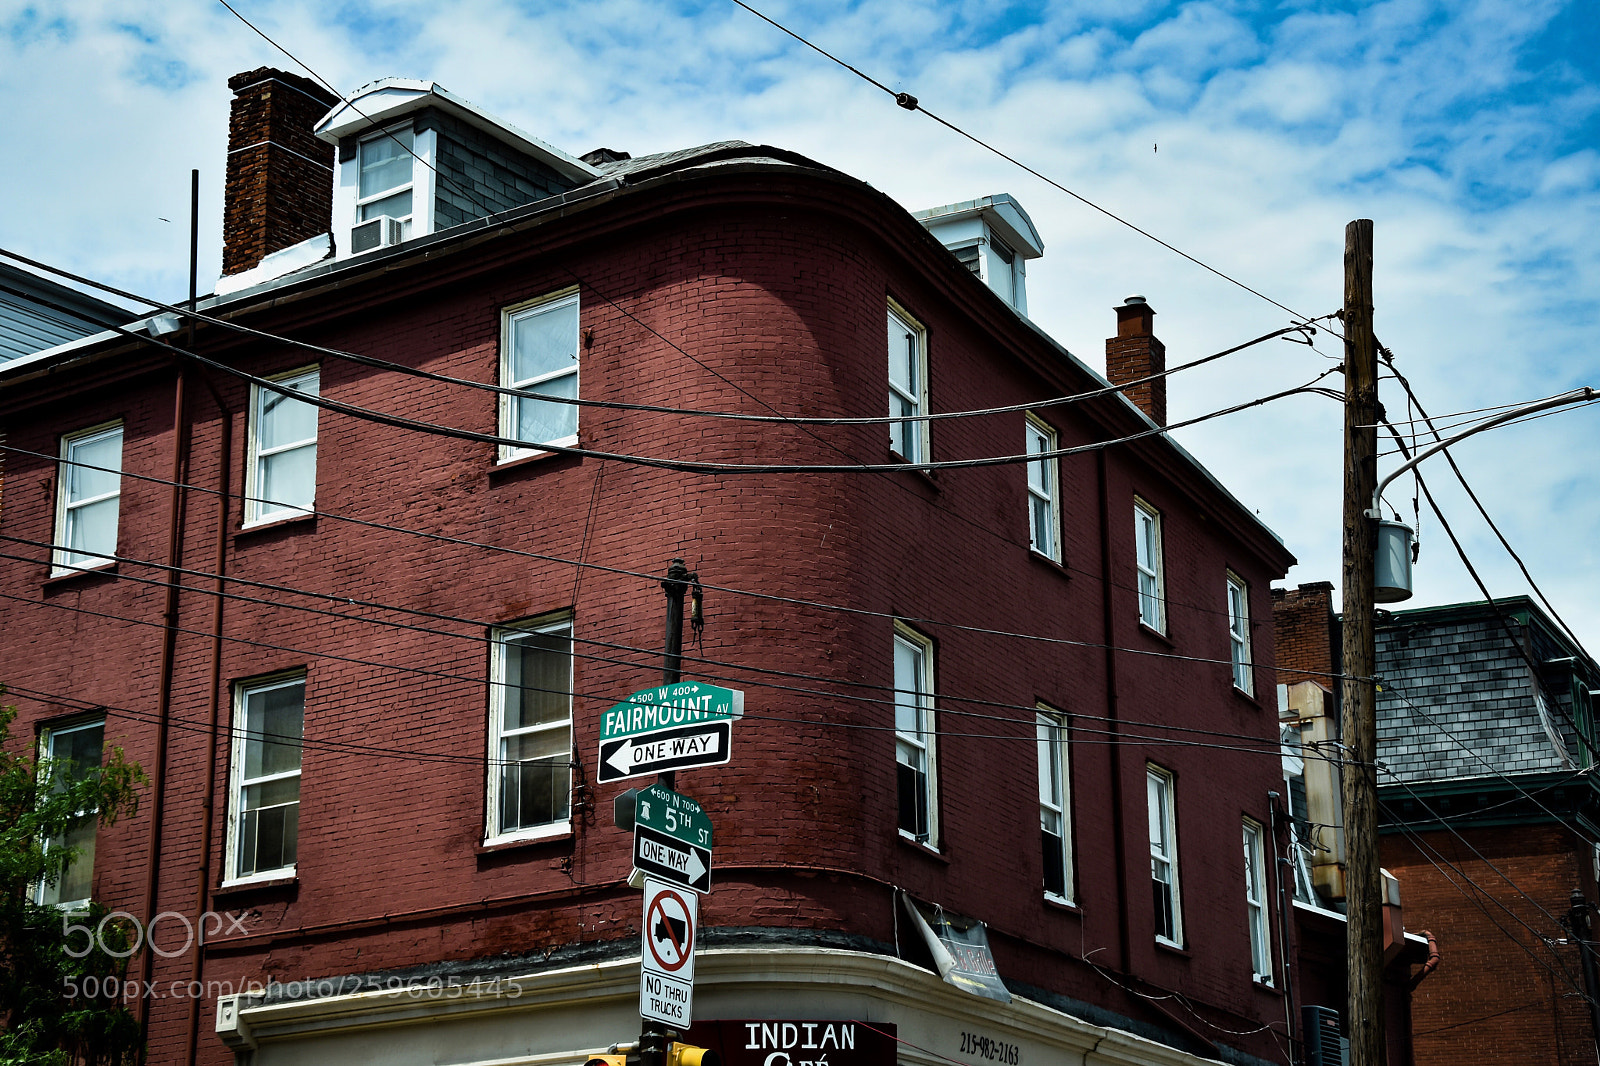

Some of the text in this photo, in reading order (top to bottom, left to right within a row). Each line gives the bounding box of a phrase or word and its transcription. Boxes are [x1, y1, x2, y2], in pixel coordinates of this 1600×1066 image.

[638, 685, 691, 703] 500 W 400
[604, 694, 729, 736] FAIRMOUNT AV
[633, 735, 712, 763] ONE WAY
[656, 789, 695, 812] 600 N 700
[665, 806, 709, 845] 5TH ST
[643, 840, 689, 871] ONE WAY
[646, 975, 688, 1003] NO THRU
[650, 997, 683, 1019] TRUCKS
[745, 1022, 855, 1050] INDIAN
[960, 1032, 1019, 1066] 215-982-2163
